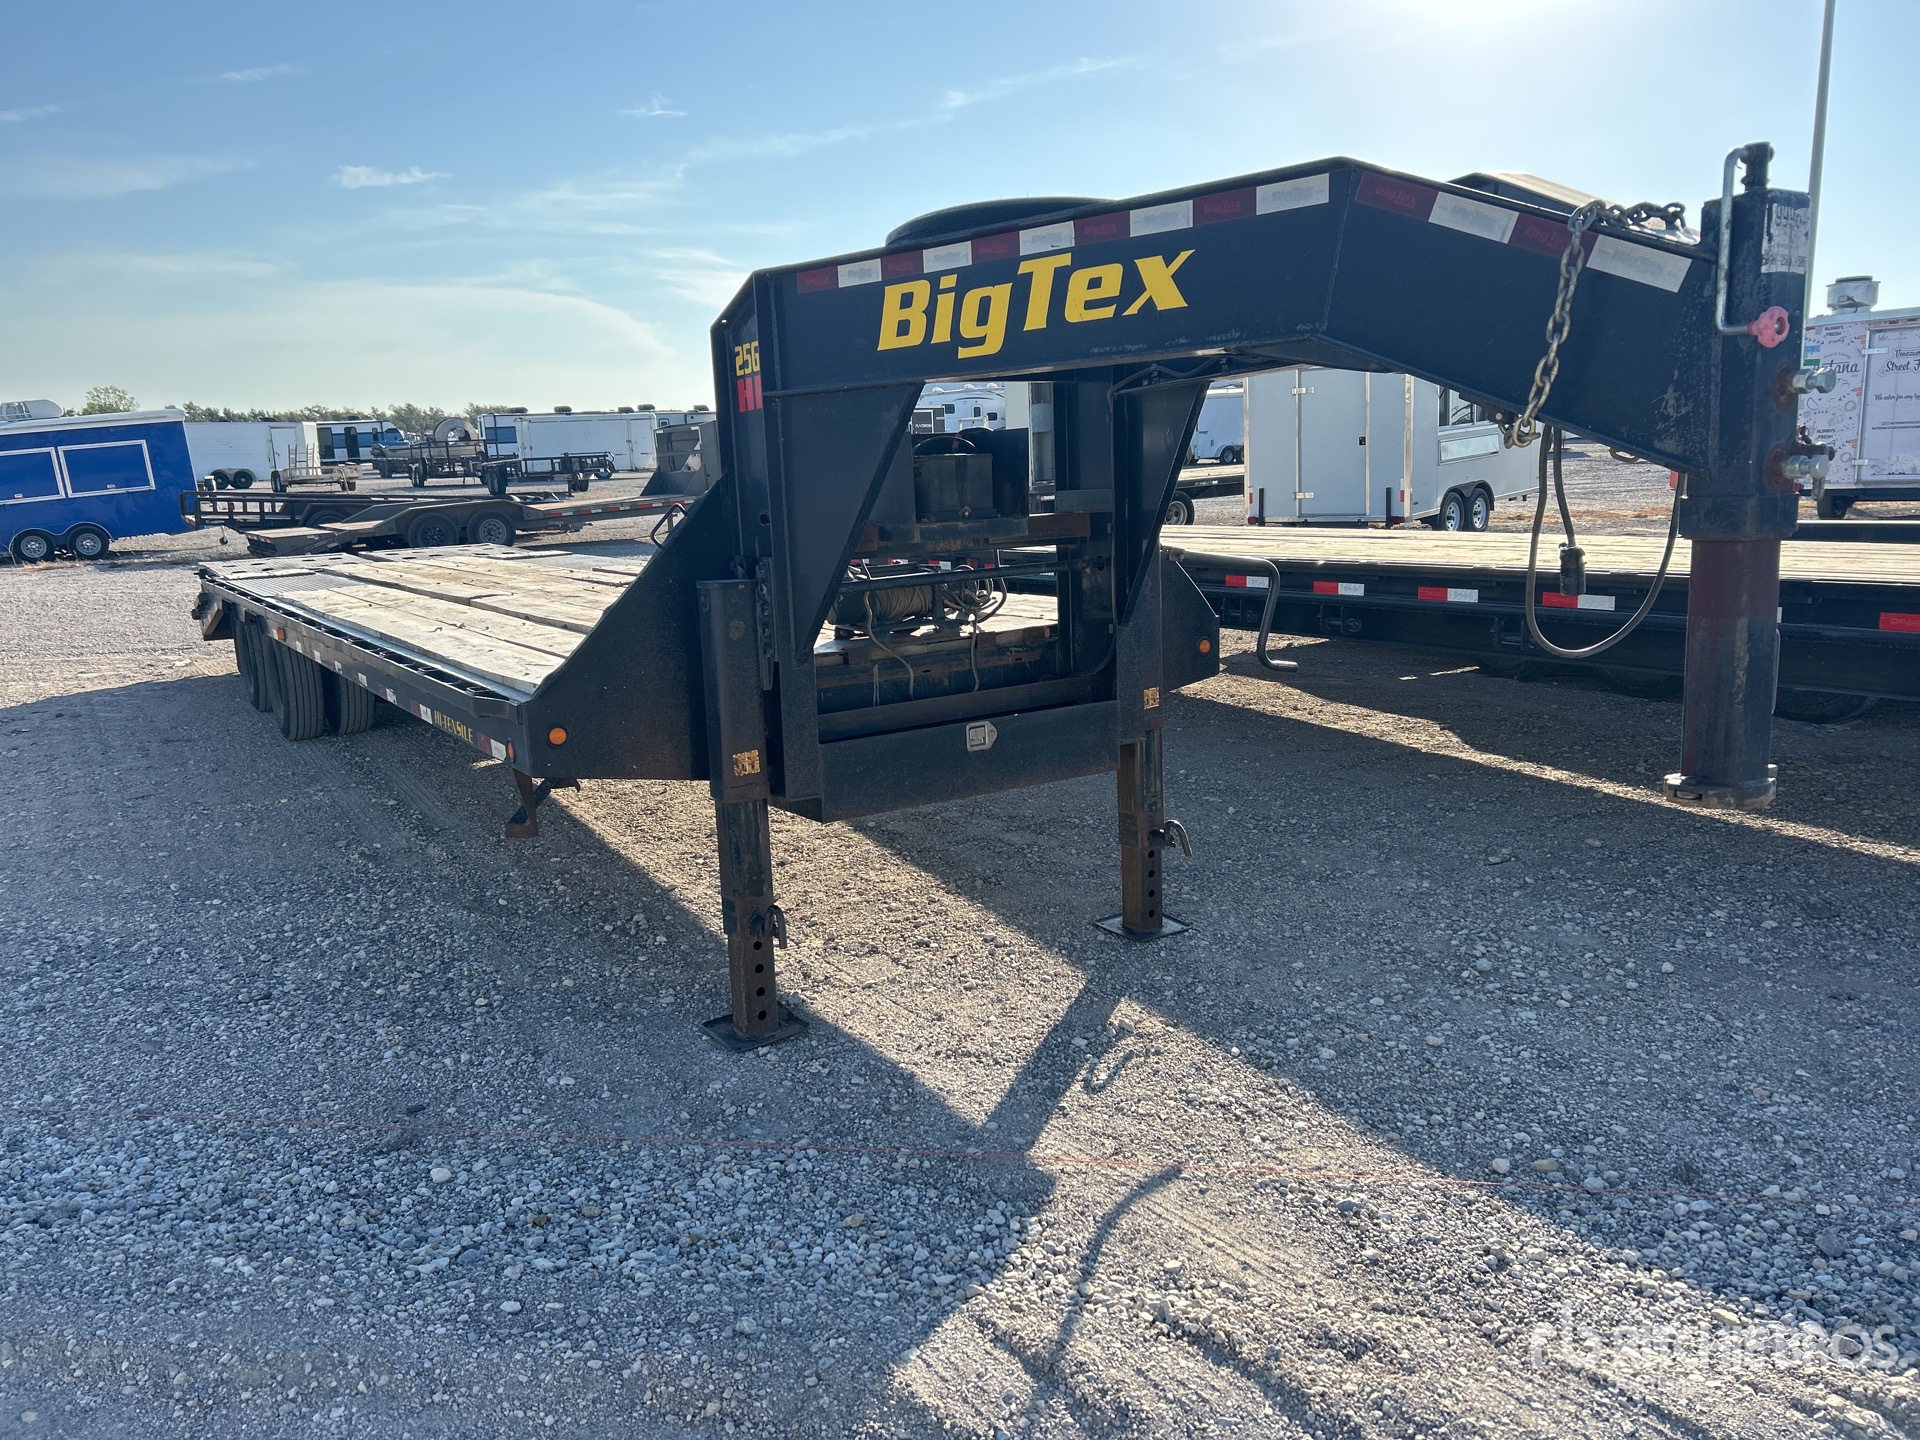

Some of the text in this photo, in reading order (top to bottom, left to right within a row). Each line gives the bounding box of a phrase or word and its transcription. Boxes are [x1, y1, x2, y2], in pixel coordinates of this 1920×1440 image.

[876, 249, 1196, 359] BigTex
[1885, 360, 1911, 373] Street
[737, 375, 763, 413] HI
[434, 710, 474, 744] HI-TENSILE
